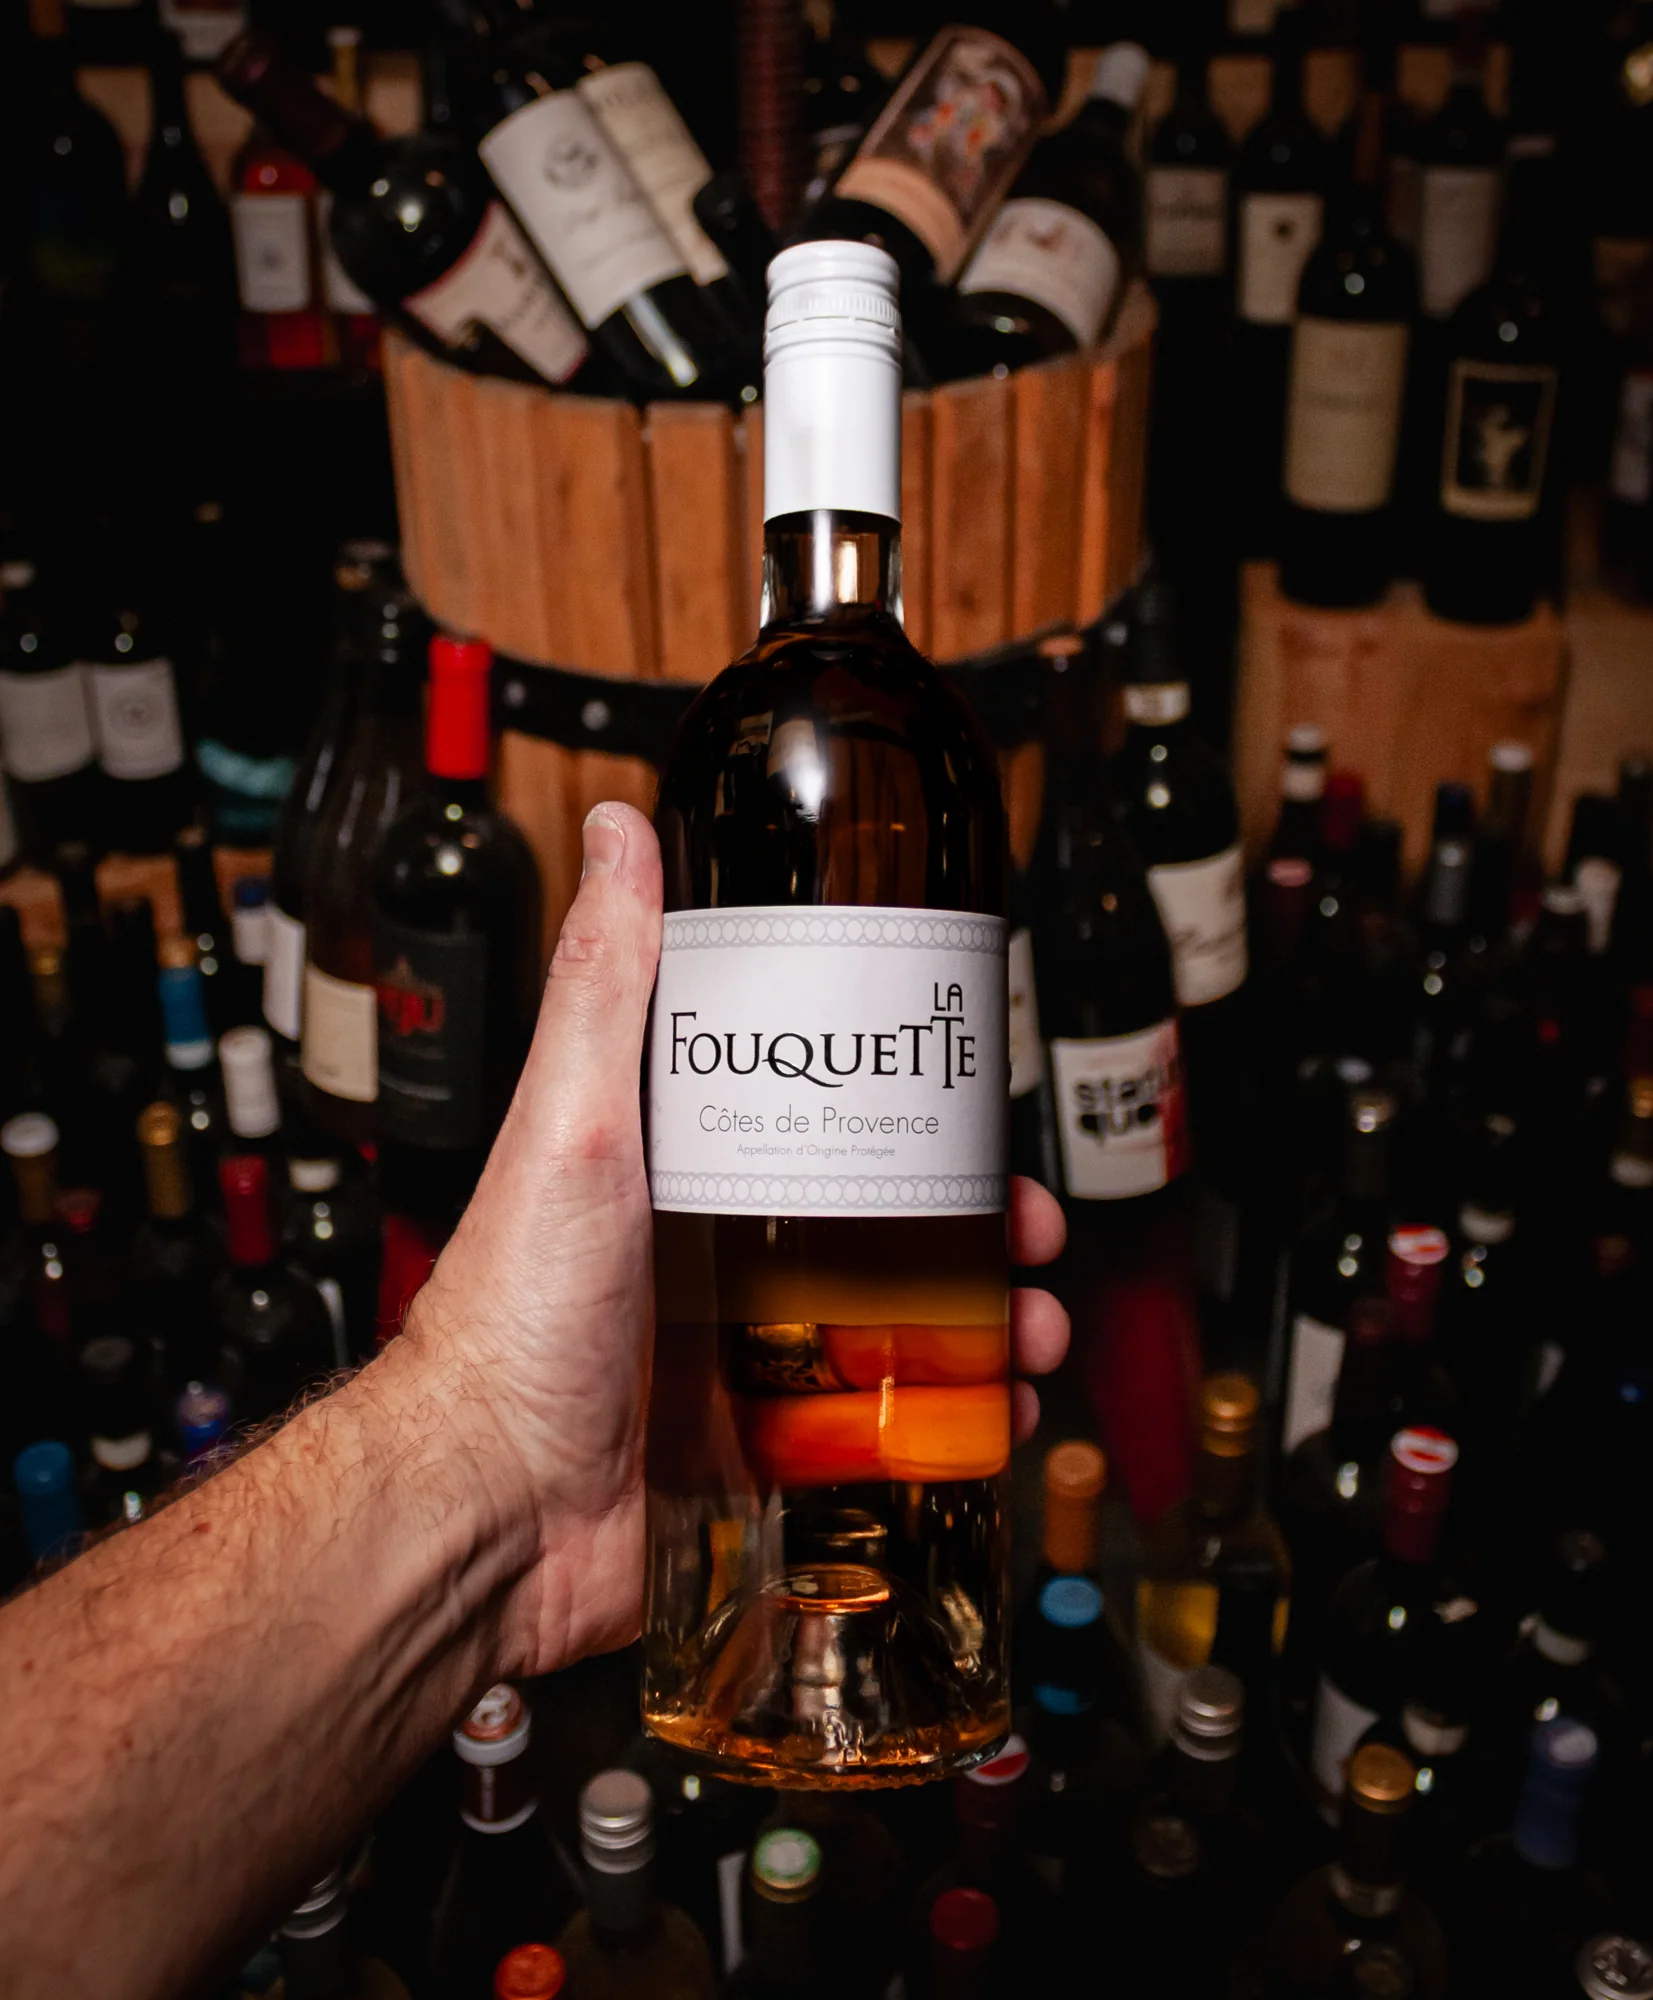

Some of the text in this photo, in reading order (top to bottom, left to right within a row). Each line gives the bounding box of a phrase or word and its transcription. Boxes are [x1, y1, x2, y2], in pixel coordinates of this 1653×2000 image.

[934, 981, 963, 1013] LA
[669, 1011, 977, 1089] FOUQUETTE
[699, 1103, 939, 1135] Côtes de Provence
[736, 1143, 896, 1160] Appellation d'Origine Protégée
